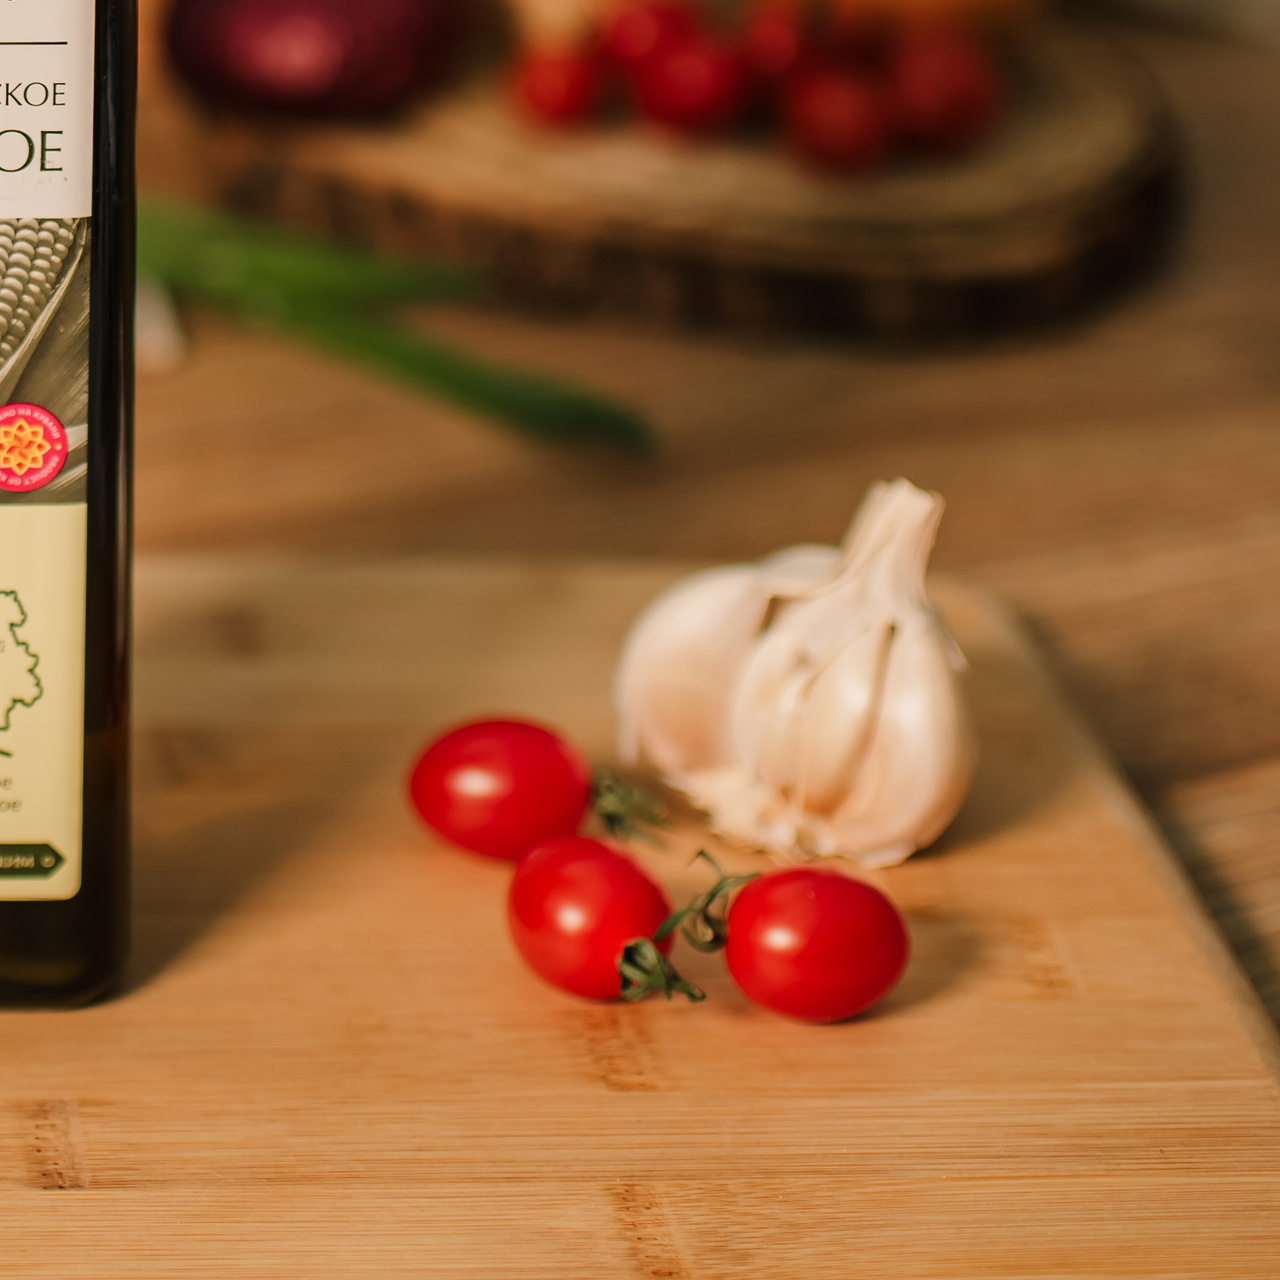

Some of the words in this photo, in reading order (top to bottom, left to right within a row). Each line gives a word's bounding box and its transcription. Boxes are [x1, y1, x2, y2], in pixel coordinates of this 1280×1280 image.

[18, 408, 32, 417] НА
[32, 410, 61, 440] КУБАНИ
[7, 477, 22, 487] OF
[23, 455, 60, 486] PRODUCT
